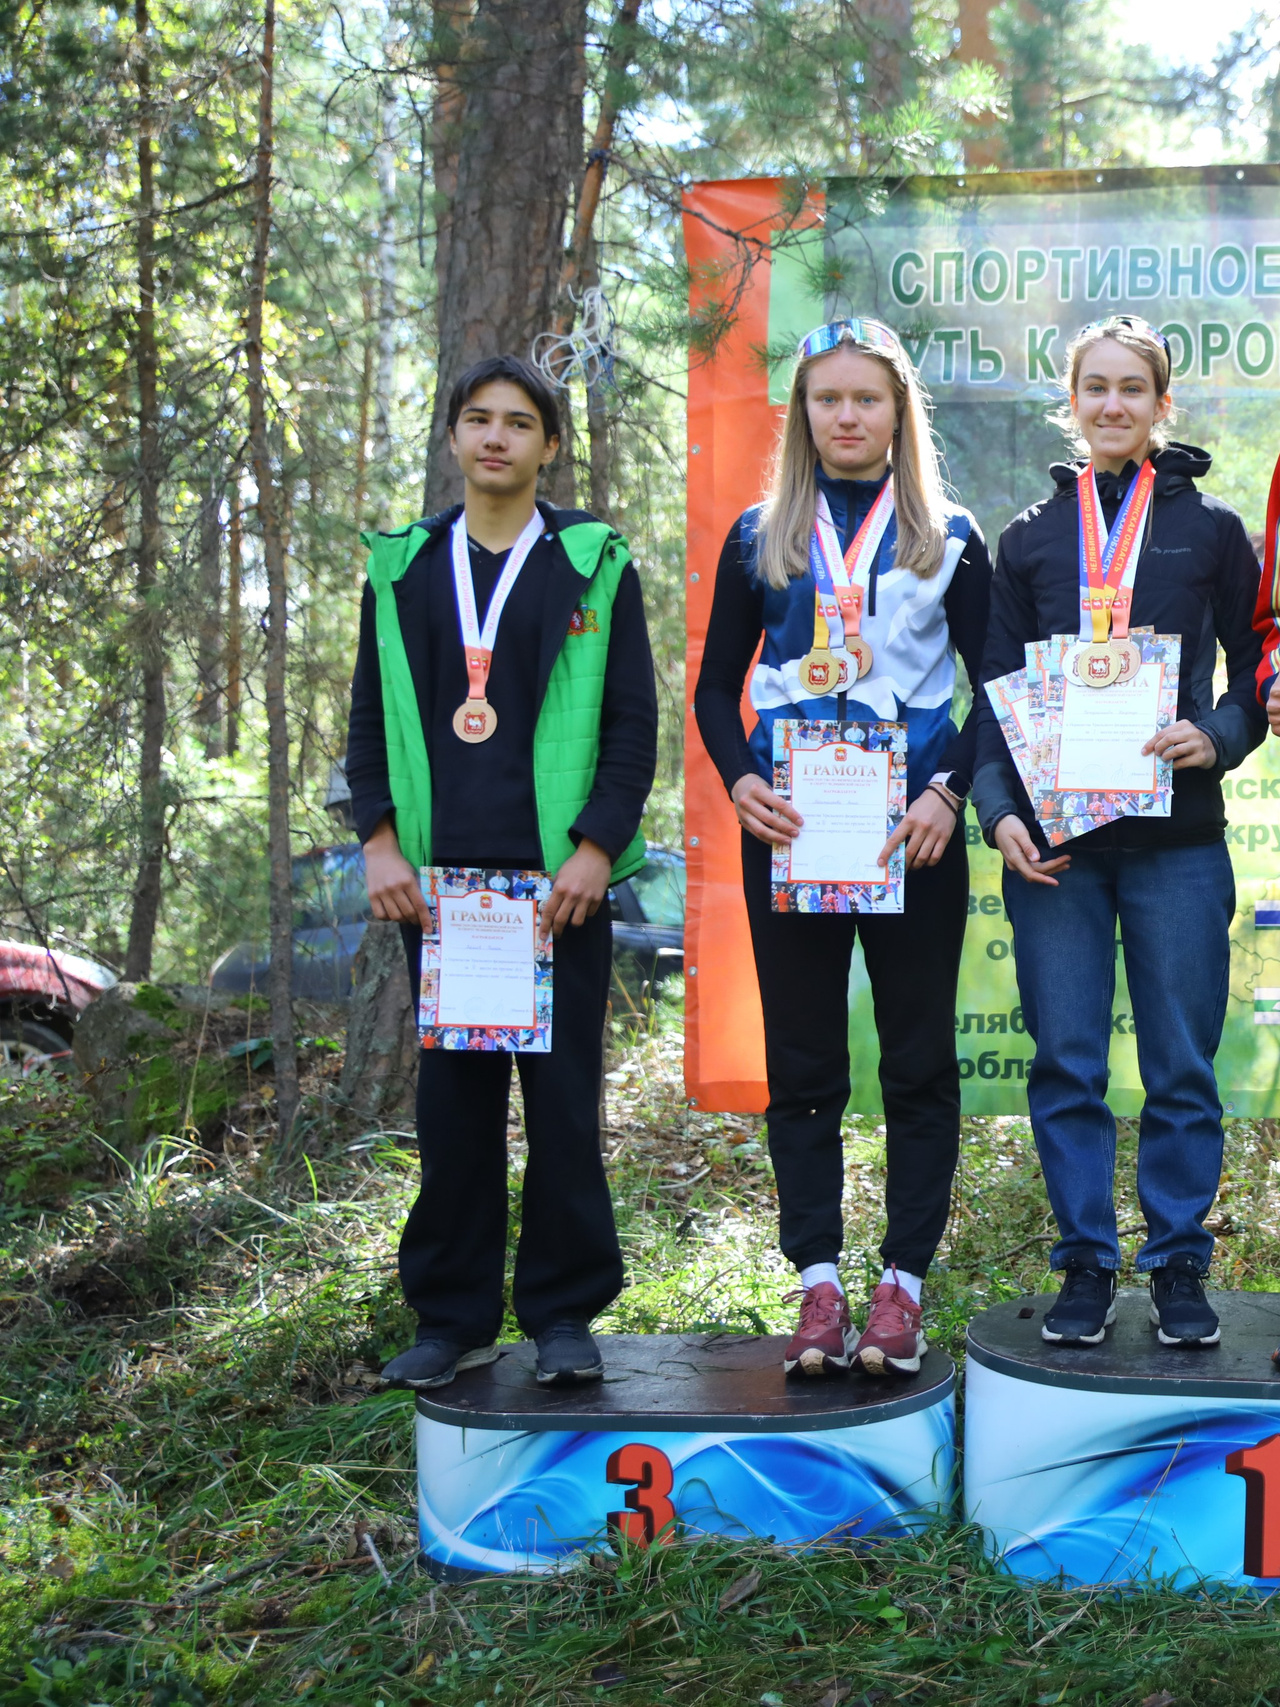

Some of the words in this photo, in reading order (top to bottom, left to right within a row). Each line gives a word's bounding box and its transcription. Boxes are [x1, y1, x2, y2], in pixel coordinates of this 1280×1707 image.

[899, 328, 1005, 383] УТЬ
[1026, 325, 1059, 383] К
[1082, 477, 1092, 512] ОБЛАСТЬ
[1127, 477, 1150, 534] ЧЕЛЯБИНСКАЯ
[846, 542, 861, 571] ОБЛАС
[1085, 513, 1097, 573] ЧЕЛЯБИНСКАЯ
[1114, 534, 1132, 572] ОБЛАСТЬ
[803, 763, 877, 777] ГРАМОТА
[451, 909, 523, 924] ГРАМОТА
[606, 1443, 676, 1554] 3
